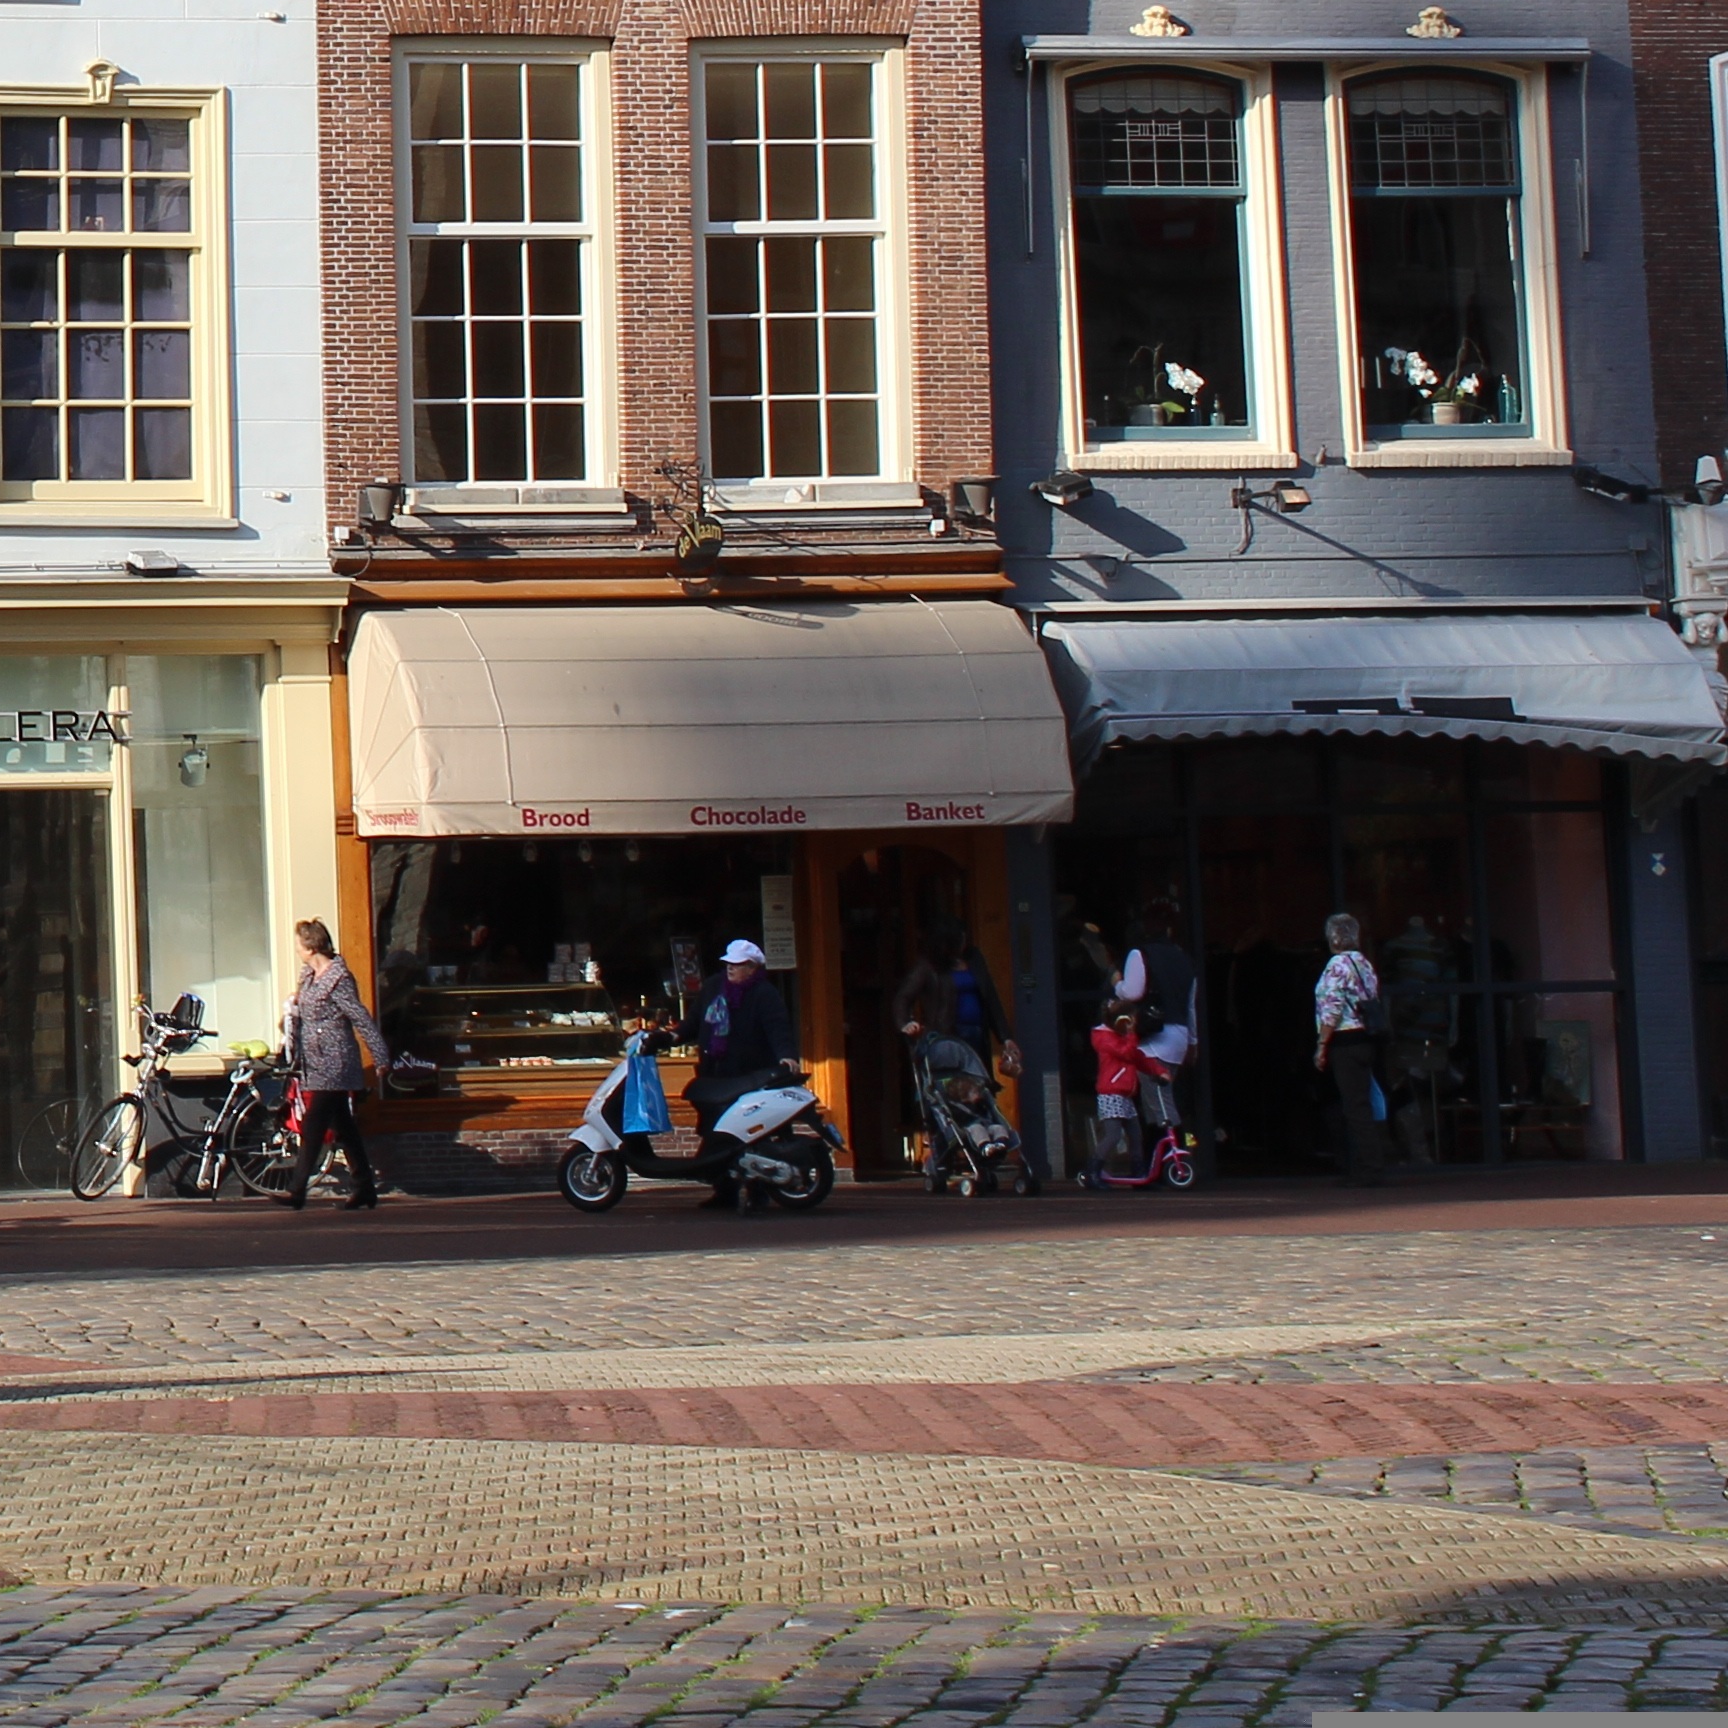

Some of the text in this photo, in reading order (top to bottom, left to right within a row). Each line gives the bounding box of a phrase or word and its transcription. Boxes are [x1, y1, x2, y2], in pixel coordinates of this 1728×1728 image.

[521, 801, 986, 828] Brood Chocolade Banket
